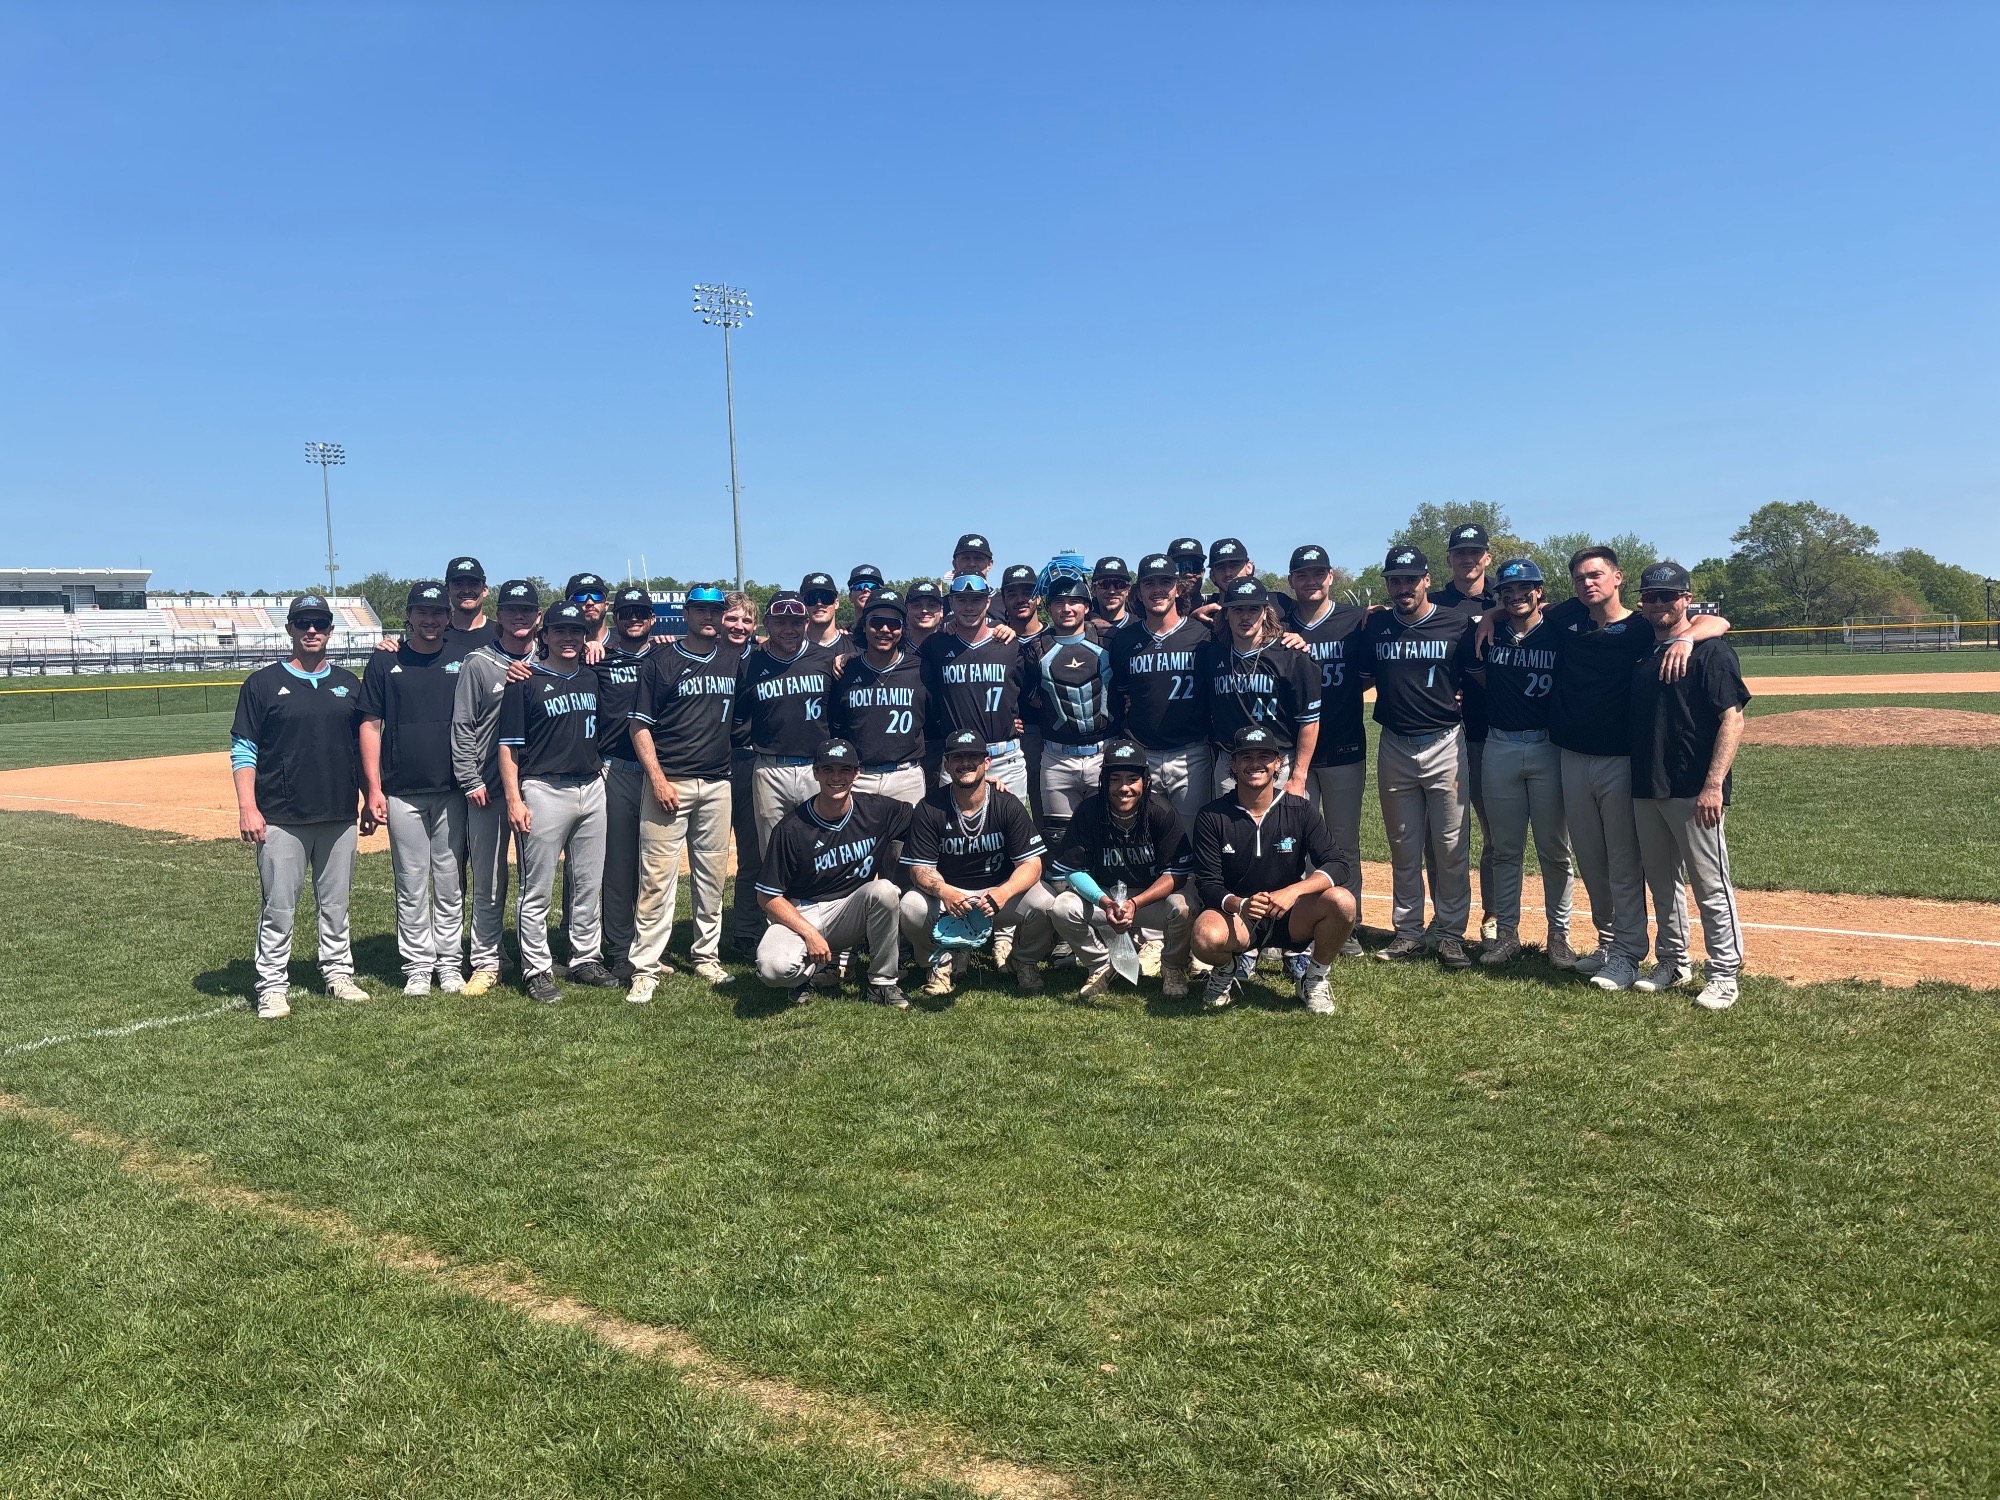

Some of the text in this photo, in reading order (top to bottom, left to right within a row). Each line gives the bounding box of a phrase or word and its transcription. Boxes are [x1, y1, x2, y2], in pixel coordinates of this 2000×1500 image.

[1307, 640, 1345, 660] FAMILY
[1375, 641, 1448, 661] HOLY FAMILY
[1488, 645, 1556, 669] HOLY FAMILY
[609, 666, 637, 684] HOLY
[942, 664, 1006, 684] HOLY FAMILY
[1130, 652, 1196, 674] HOLY FAMILY
[1321, 663, 1345, 687] 55
[678, 675, 736, 697] HOLY FAMILY
[756, 675, 824, 701] HOLY FAMILY
[1168, 675, 1194, 700] 22
[1214, 674, 1235, 695] HOLY
[1426, 664, 1436, 688] 1
[1524, 673, 1553, 697] 29
[543, 695, 571, 718] HOLY
[804, 697, 822, 721] 16
[849, 688, 914, 708] HOLY FAMILY
[985, 687, 1003, 712] 17
[1252, 697, 1278, 722] 44
[720, 699, 731, 723] 7
[885, 710, 913, 734] 20
[939, 832, 1005, 855] HOLY FAMILY
[814, 848, 838, 875] HOLY
